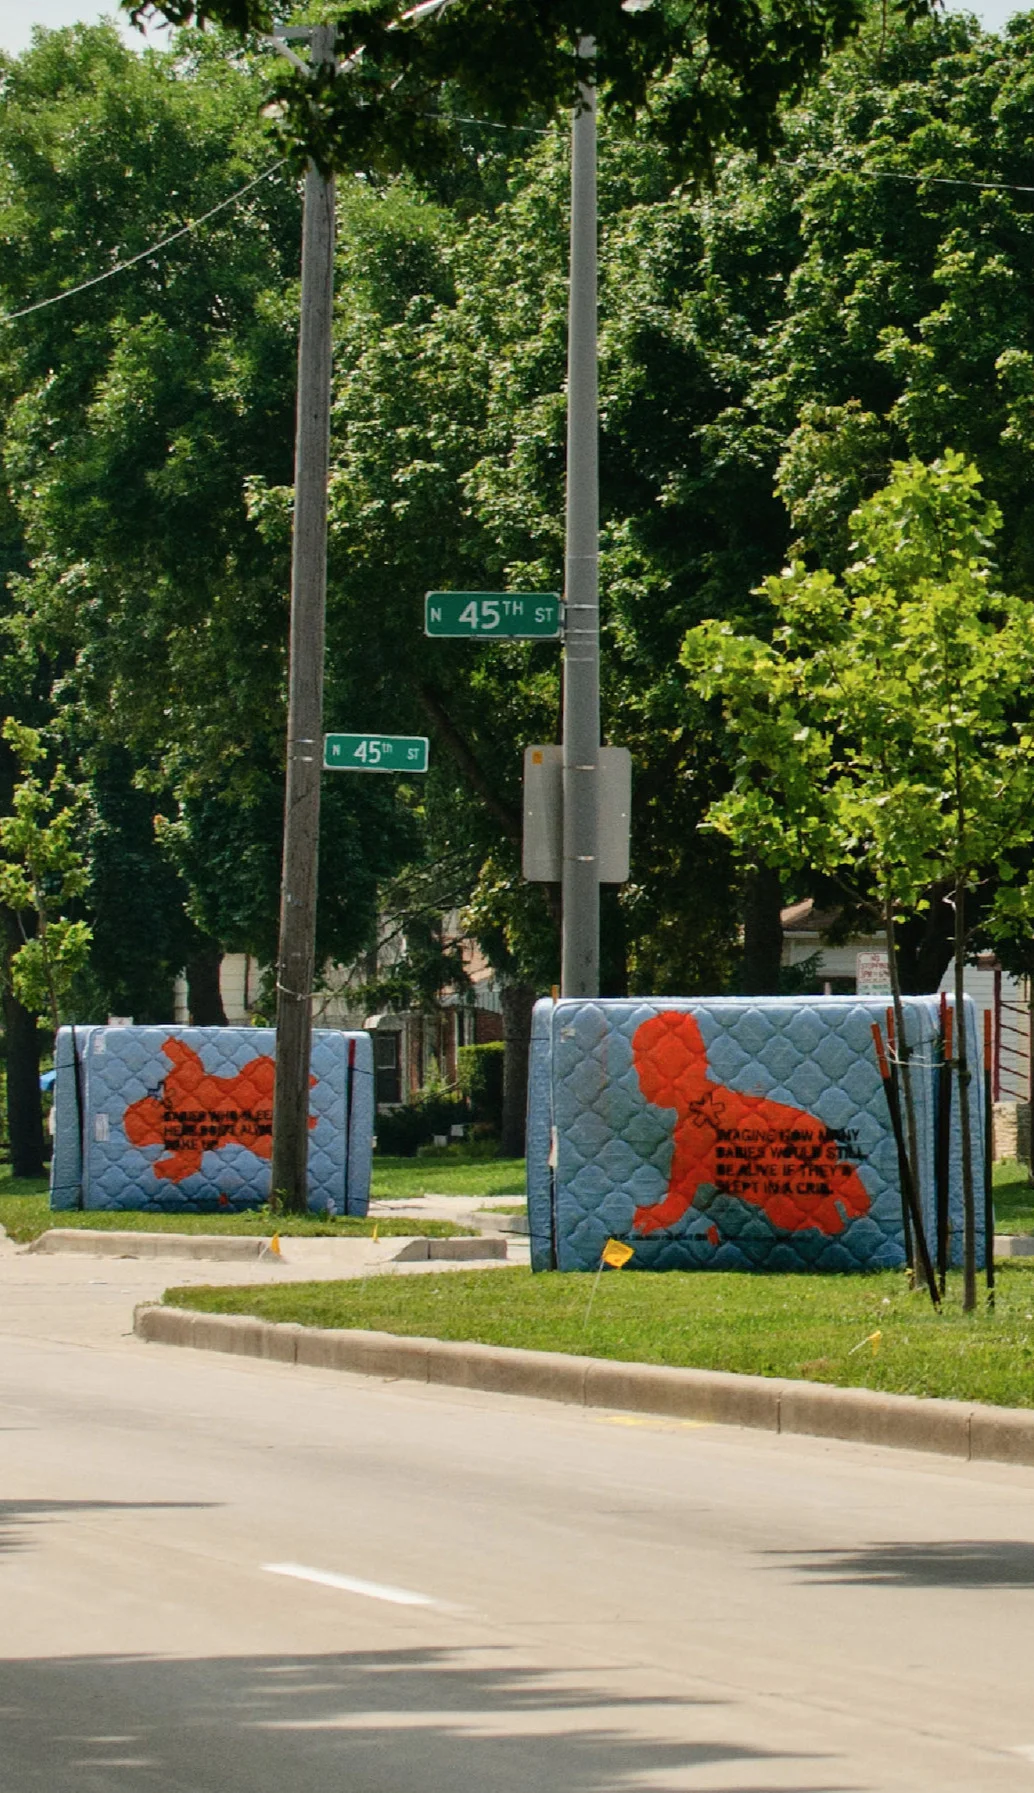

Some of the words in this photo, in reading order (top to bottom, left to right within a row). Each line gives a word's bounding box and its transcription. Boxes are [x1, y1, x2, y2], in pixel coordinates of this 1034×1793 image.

[430, 608, 442, 623] N
[458, 600, 524, 630] 45TH
[534, 607, 554, 623] ST
[332, 744, 341, 756] N
[353, 740, 394, 764] 45th
[407, 748, 420, 760] ST
[716, 1128, 777, 1141] IMAGINE
[779, 1128, 813, 1141] HOW
[818, 1127, 860, 1142] MANY
[782, 1164, 797, 1176] IF
[763, 1180, 778, 1194] IN
